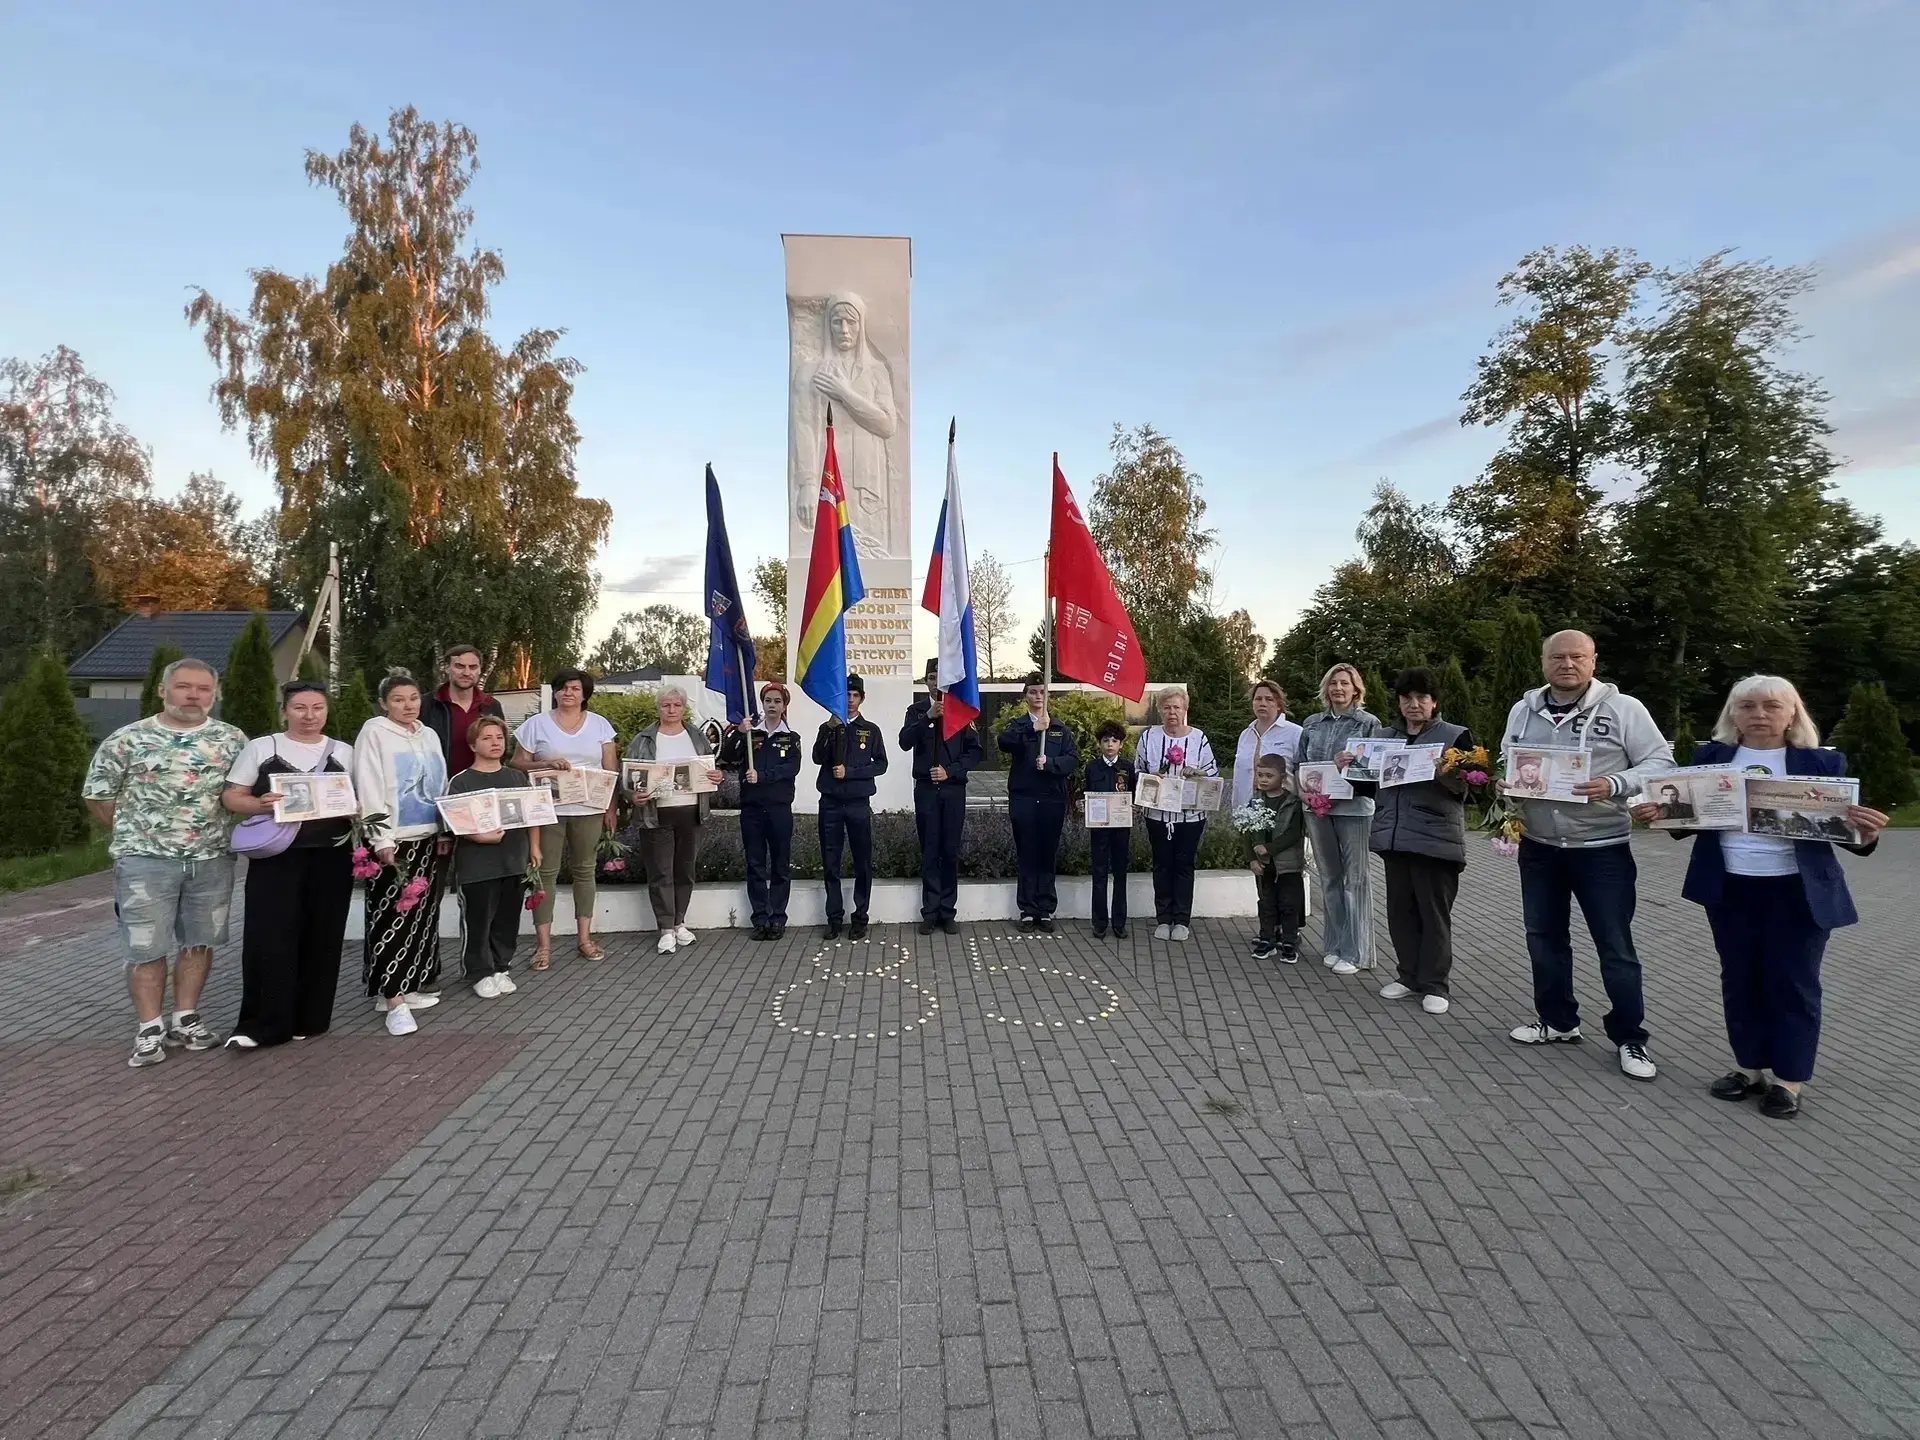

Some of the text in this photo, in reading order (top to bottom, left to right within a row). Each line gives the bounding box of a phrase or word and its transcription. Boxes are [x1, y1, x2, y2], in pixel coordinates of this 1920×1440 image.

[872, 588, 909, 599] СЛАВА
[845, 619, 869, 630] ШИМ
[880, 619, 909, 630] БОЯХ
[847, 634, 896, 645] А НАШУ
[846, 649, 907, 660] ВЕТСКУЮ
[848, 664, 898, 676] ОДИНУ!
